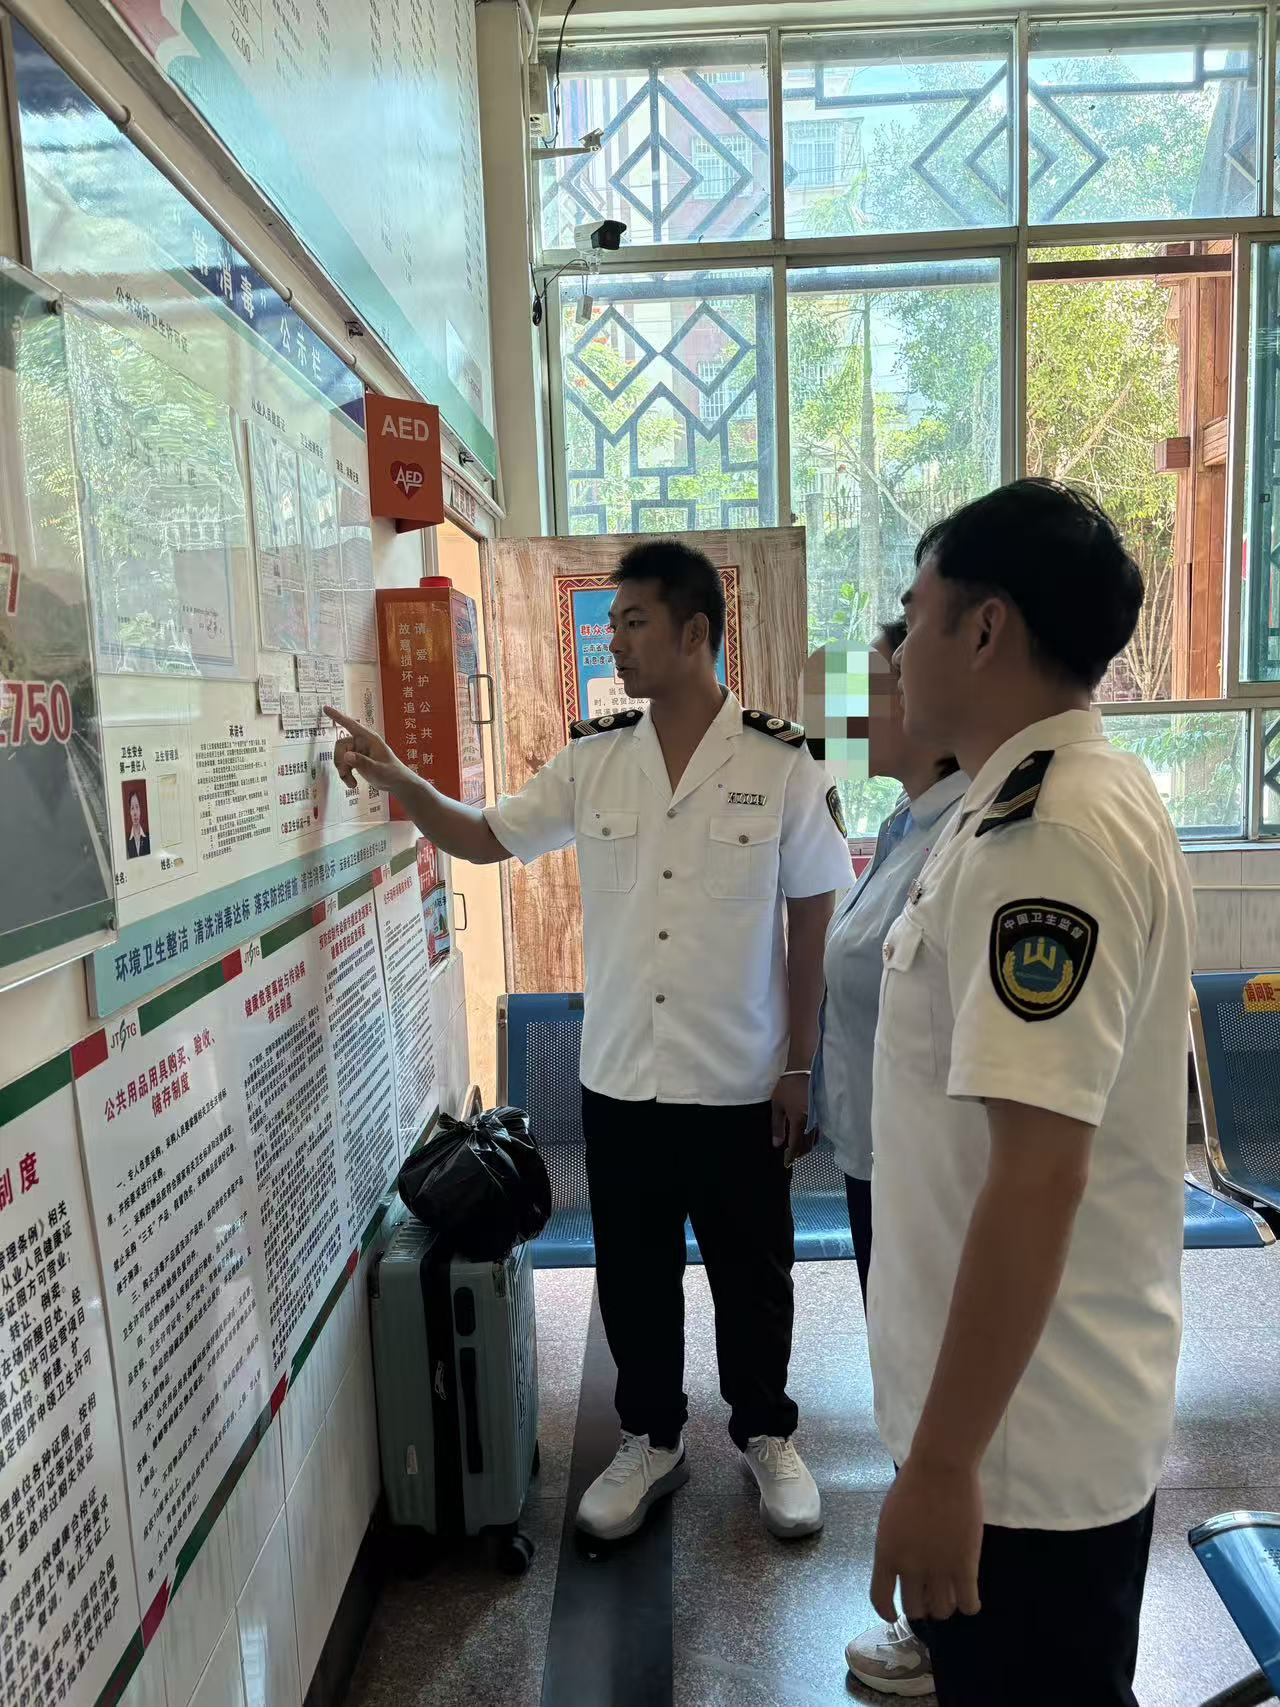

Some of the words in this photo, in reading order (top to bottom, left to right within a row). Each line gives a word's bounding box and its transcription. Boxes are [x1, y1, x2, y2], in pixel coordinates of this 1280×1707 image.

[381, 414, 429, 442] AED
[395, 466, 424, 490] AED
[0, 682, 73, 748] 750
[114, 925, 190, 983] 环境卫生整洁
[194, 897, 251, 945] 清洗消毒达标
[253, 876, 299, 917] 落实防控措施
[1004, 912, 1085, 940] 中国卫生监督
[244, 960, 307, 1019] 健康危害事故与传染病
[267, 992, 293, 1025] 报告制度
[104, 1027, 216, 1123] 公共用品用具购买、验收、
[151, 1071, 190, 1118] 储存制度
[2, 1220, 73, 1297] 从业人员健康证
[0, 1286, 82, 1385] 在场所醒目处，经
[0, 1336, 80, 1441] 照相符。新建、扩
